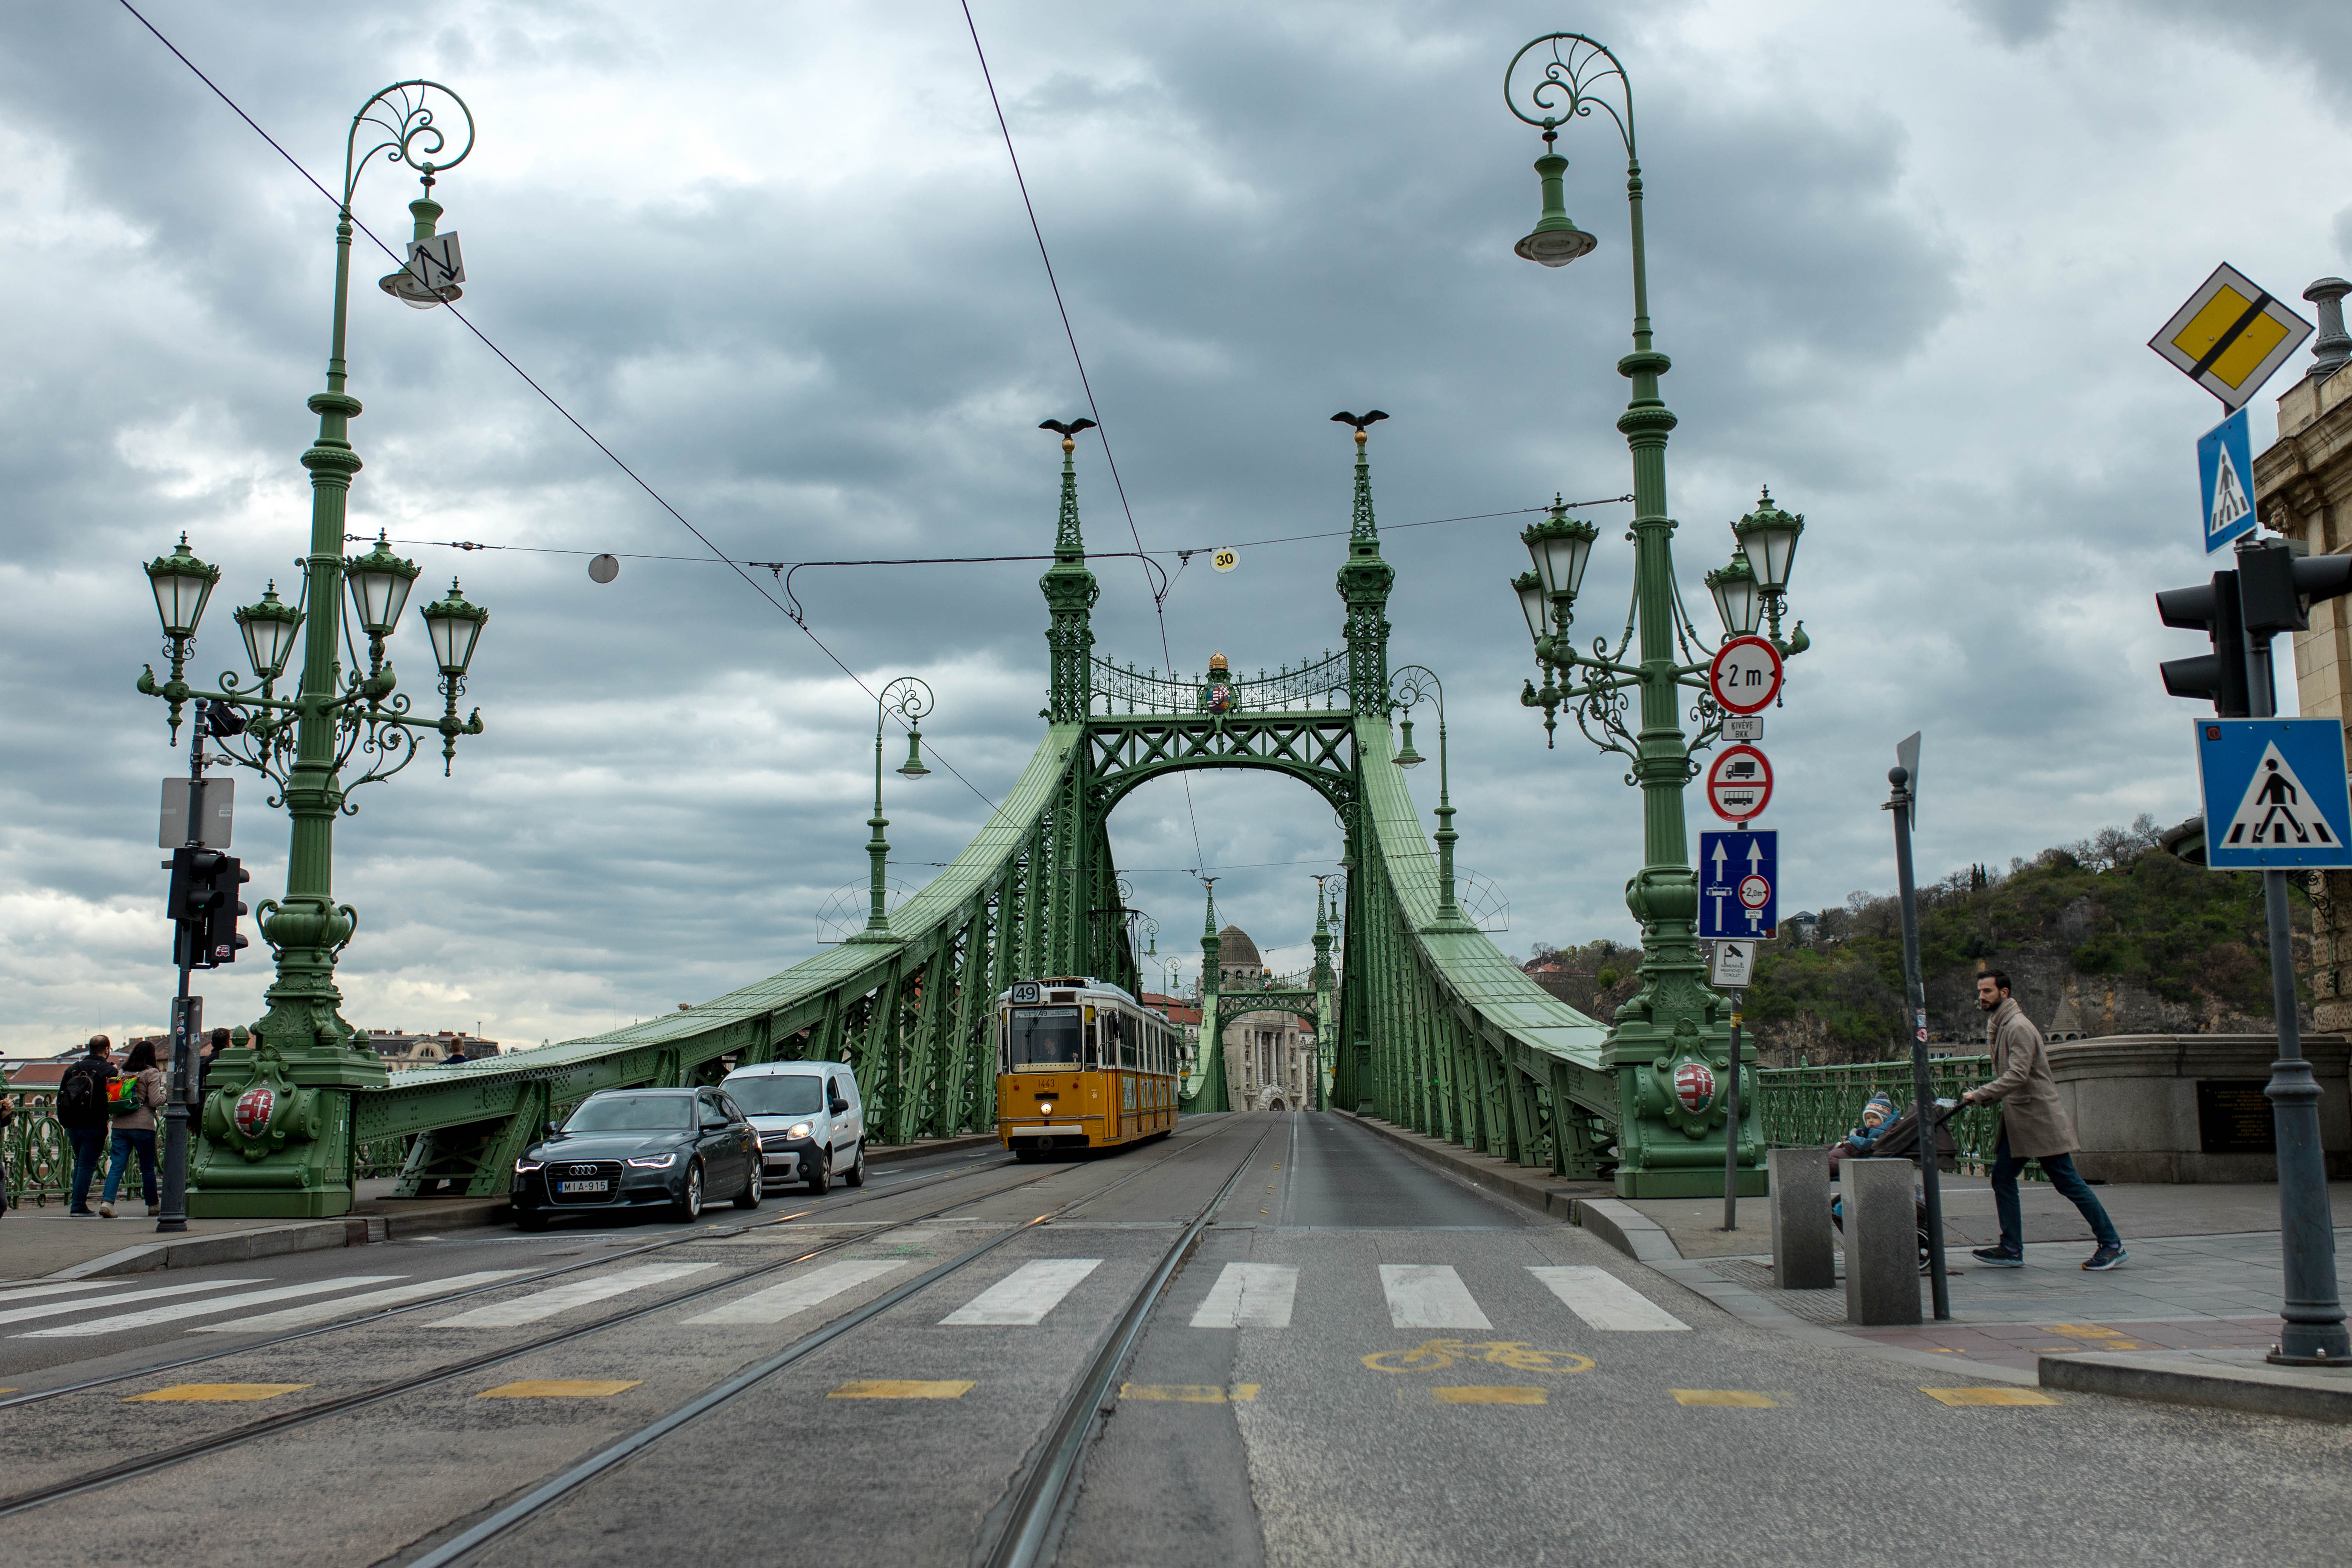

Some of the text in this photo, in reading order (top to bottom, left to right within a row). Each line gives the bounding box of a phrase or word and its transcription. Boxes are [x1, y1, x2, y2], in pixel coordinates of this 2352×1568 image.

[1216, 553, 1234, 566] 30
[1729, 664, 1761, 687] 2 m
[1016, 987, 1036, 1000] 49
[1038, 1078, 1055, 1087] 1443
[565, 1182, 605, 1191] MIA-915
